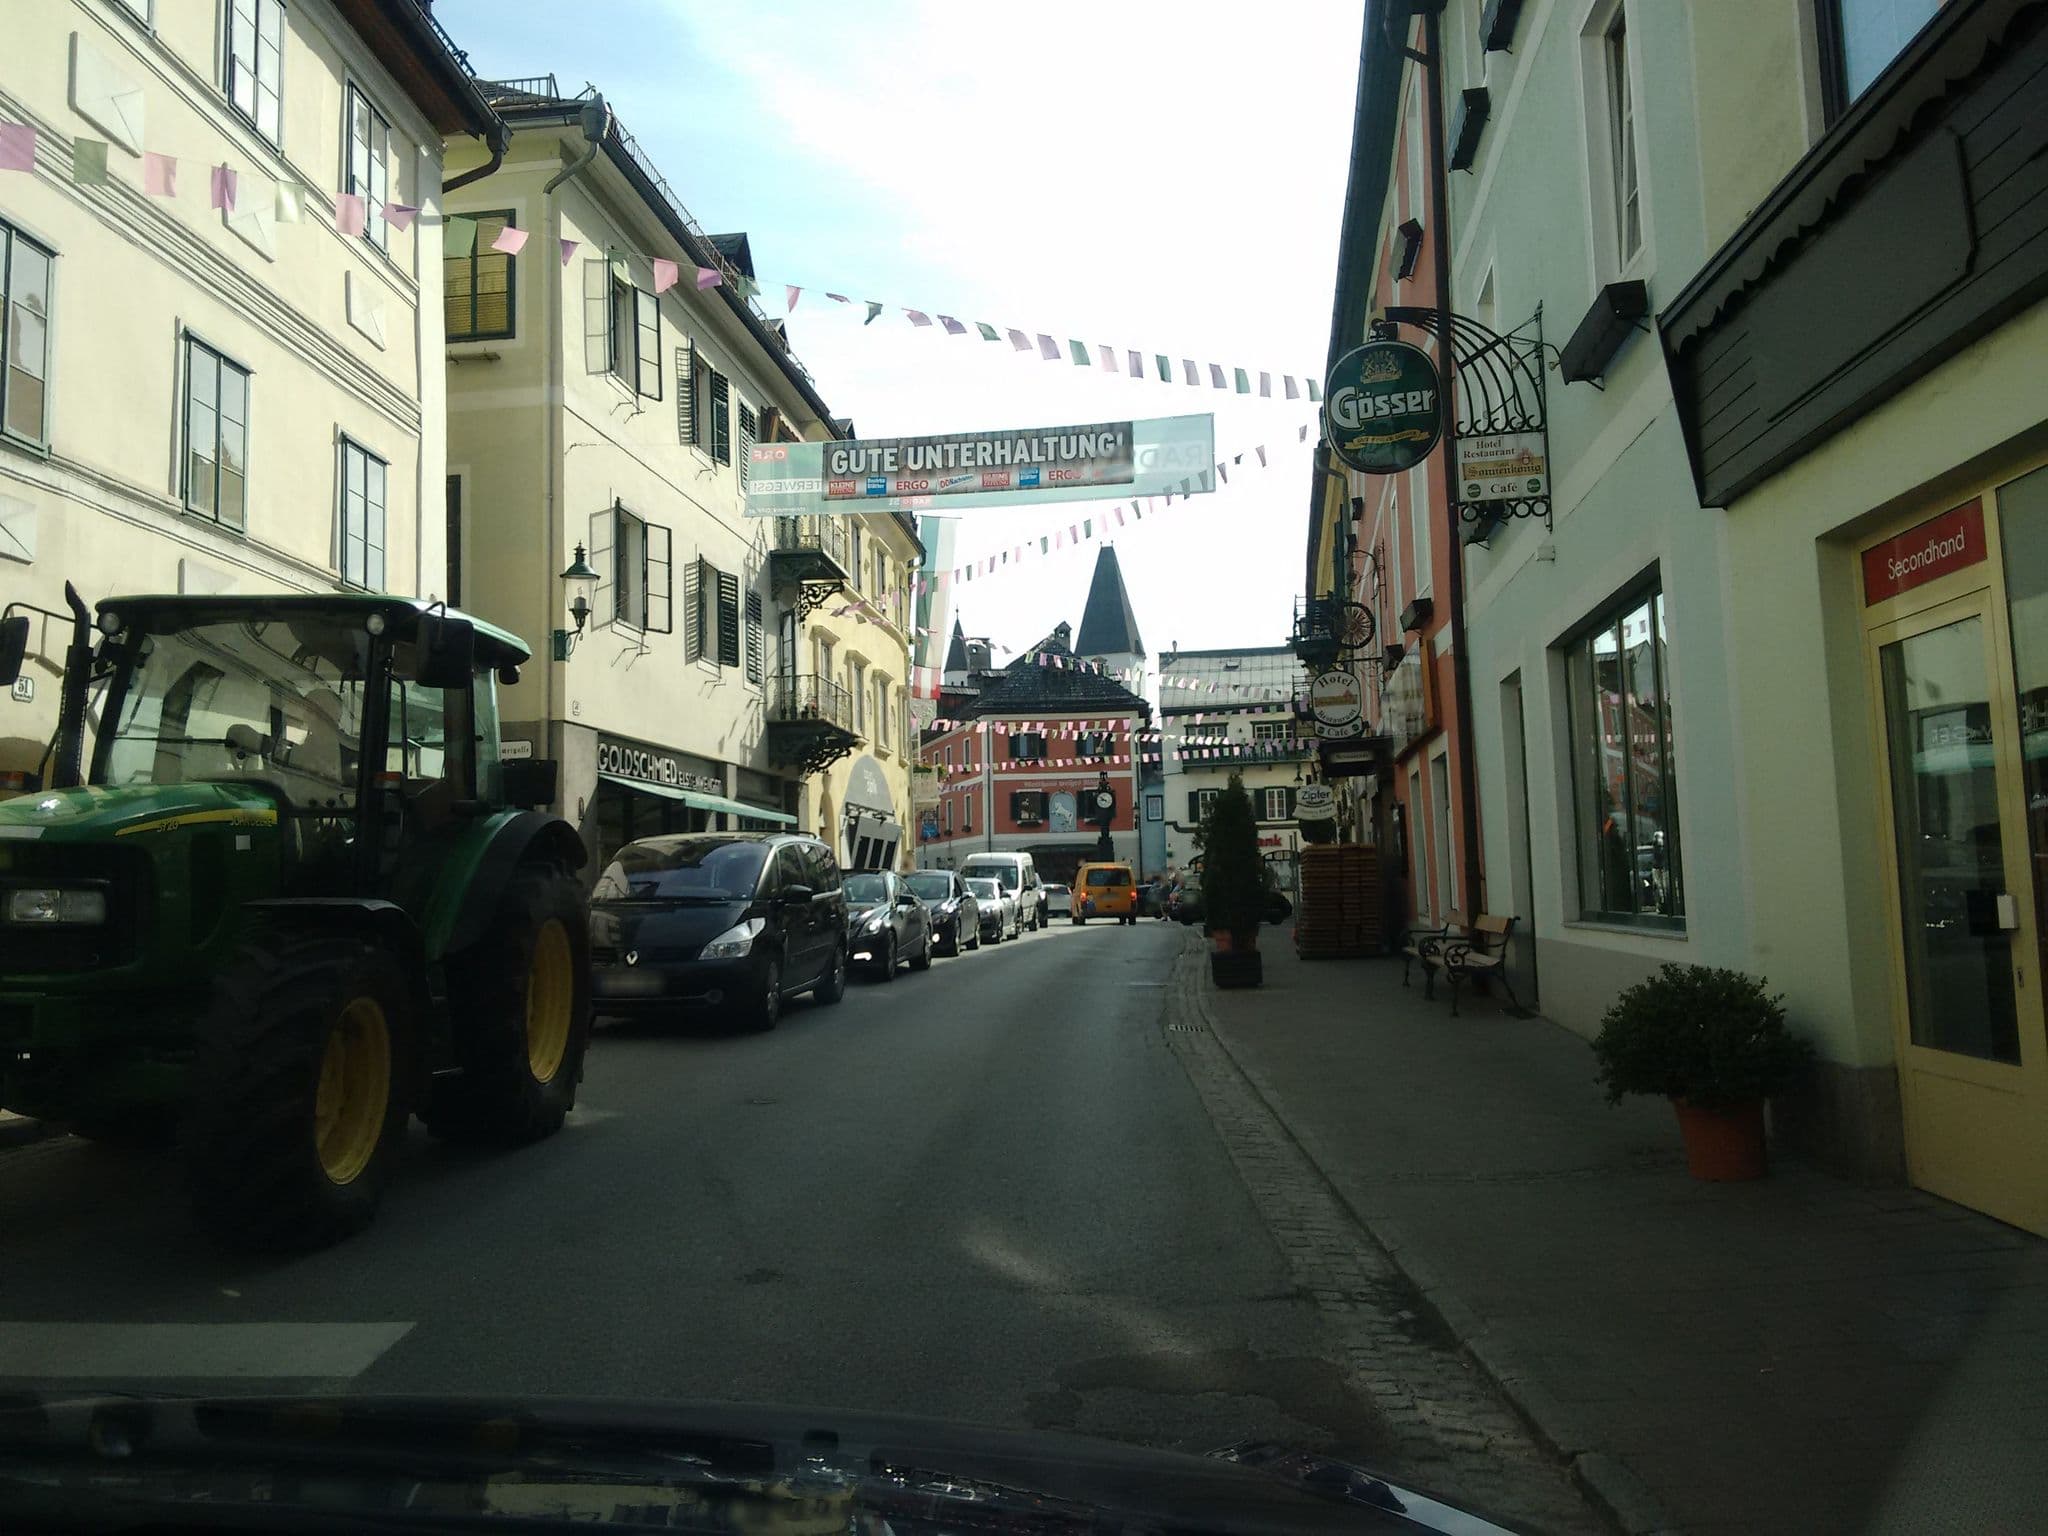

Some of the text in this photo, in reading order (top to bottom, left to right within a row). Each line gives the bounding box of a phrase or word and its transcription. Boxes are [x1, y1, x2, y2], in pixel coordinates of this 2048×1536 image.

[1330, 386, 1435, 430] Gösser
[1476, 440, 1502, 449] Hotel
[831, 431, 1124, 475] GUTE UNTERHALTUNG!
[1463, 448, 1516, 459] Restaurant
[896, 480, 929, 490] ERGO
[1888, 526, 1965, 580] Secondhand
[1319, 676, 1353, 688] Hotel
[598, 743, 678, 784] GOLDSCHMIED
[1256, 834, 1282, 847] ank
